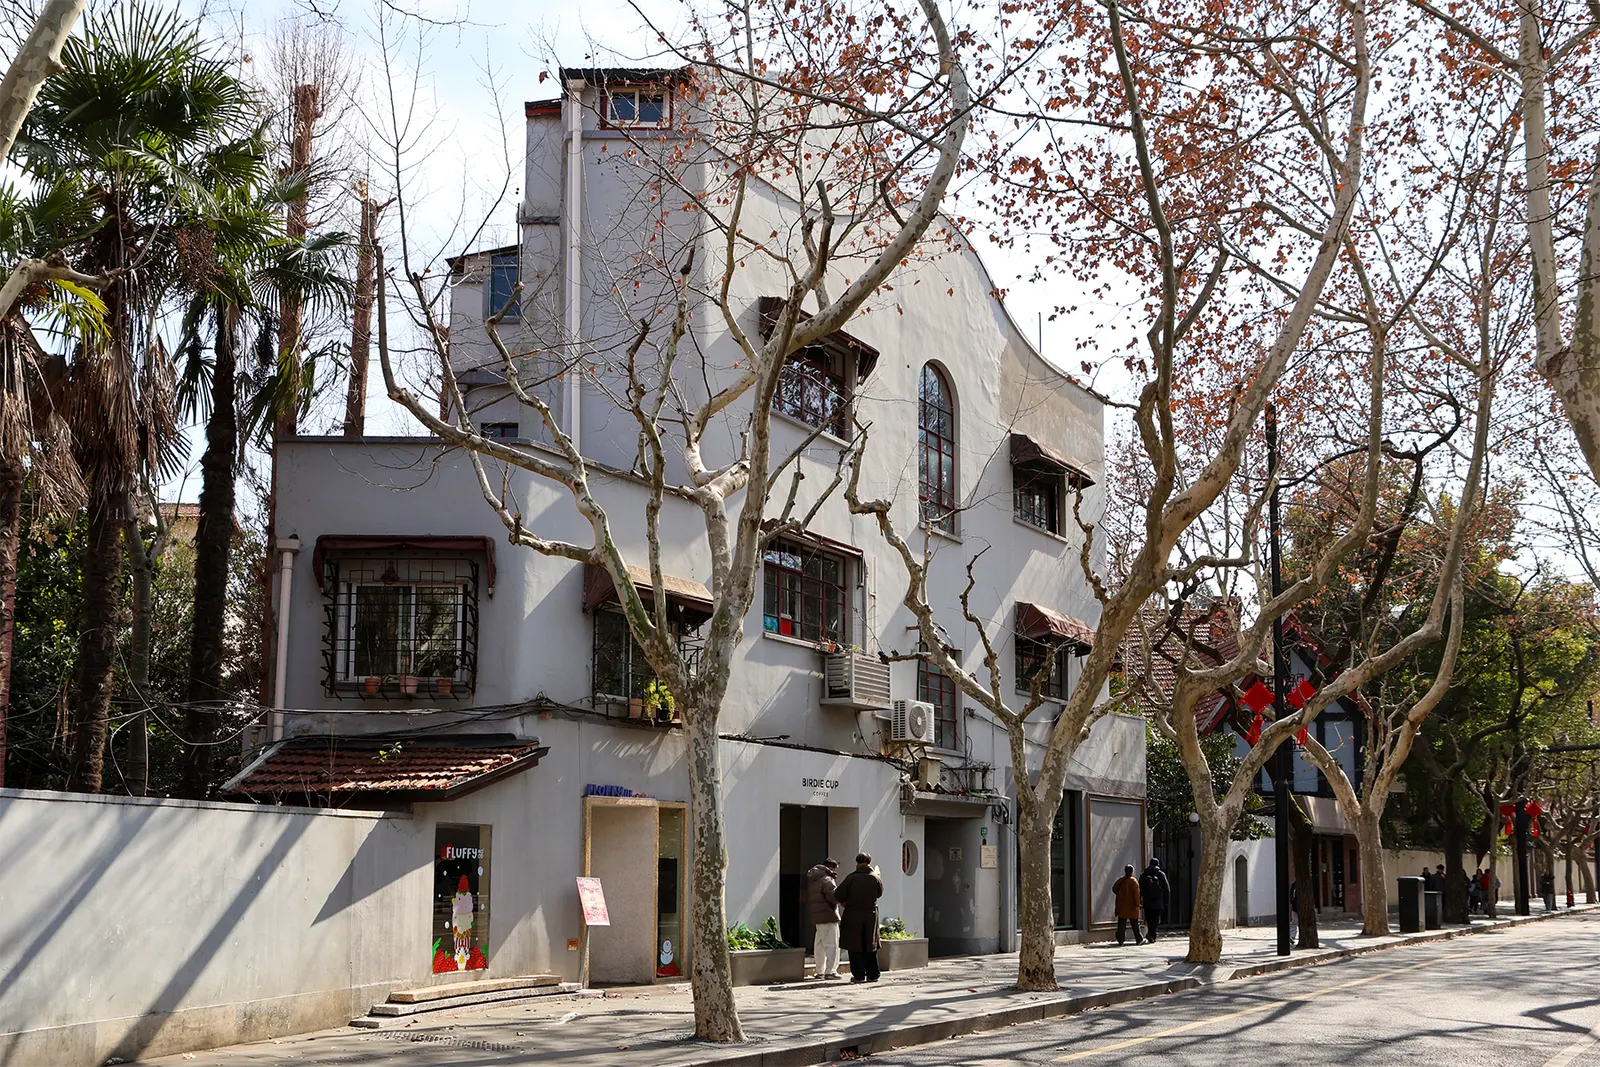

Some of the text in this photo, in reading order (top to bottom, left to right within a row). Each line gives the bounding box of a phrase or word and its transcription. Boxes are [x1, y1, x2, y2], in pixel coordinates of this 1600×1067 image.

[802, 777, 839, 789] BIRDIE CUP
[446, 846, 478, 860] FLUFFY
